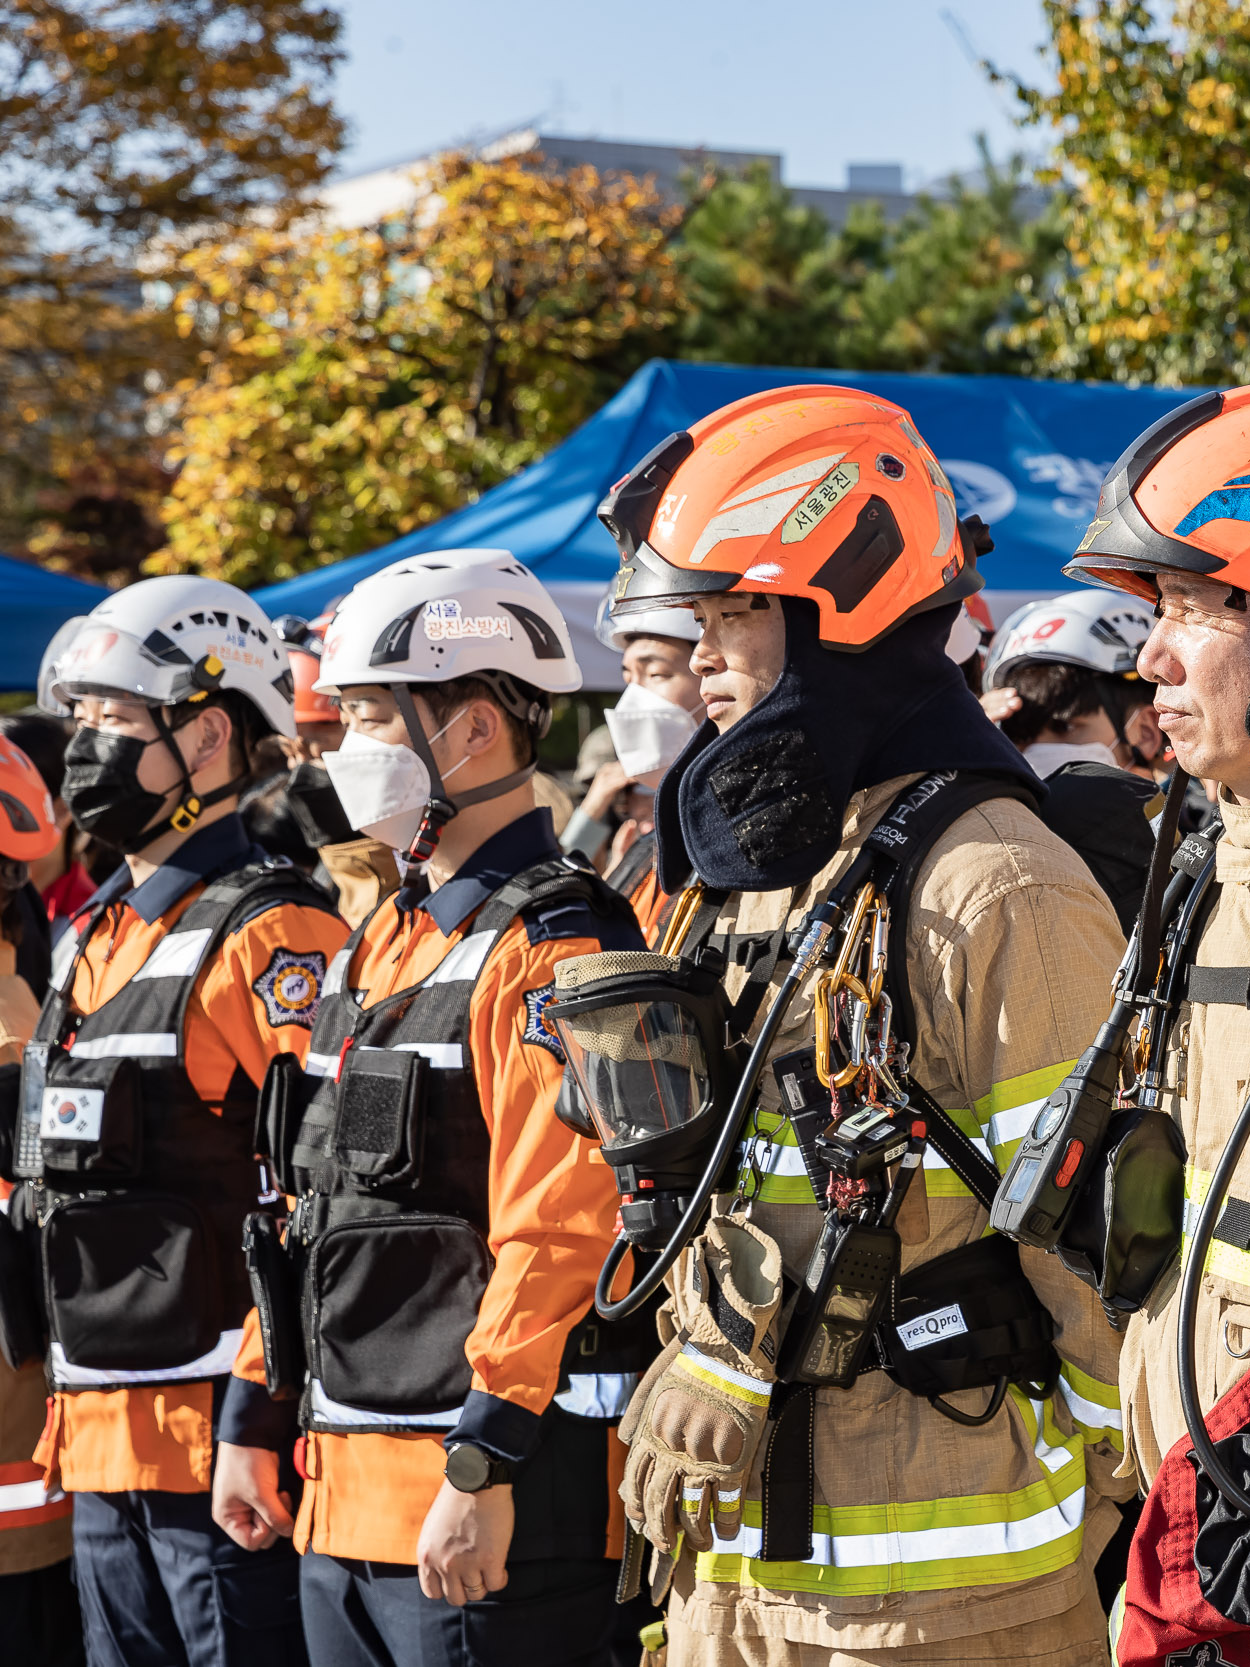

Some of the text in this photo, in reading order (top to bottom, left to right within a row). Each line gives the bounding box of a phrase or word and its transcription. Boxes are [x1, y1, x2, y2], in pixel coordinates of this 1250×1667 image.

[795, 471, 851, 530] 서울광진
[427, 601, 457, 618] 서울
[428, 619, 509, 638] 광진소방서
[906, 1313, 959, 1339] resQpro
